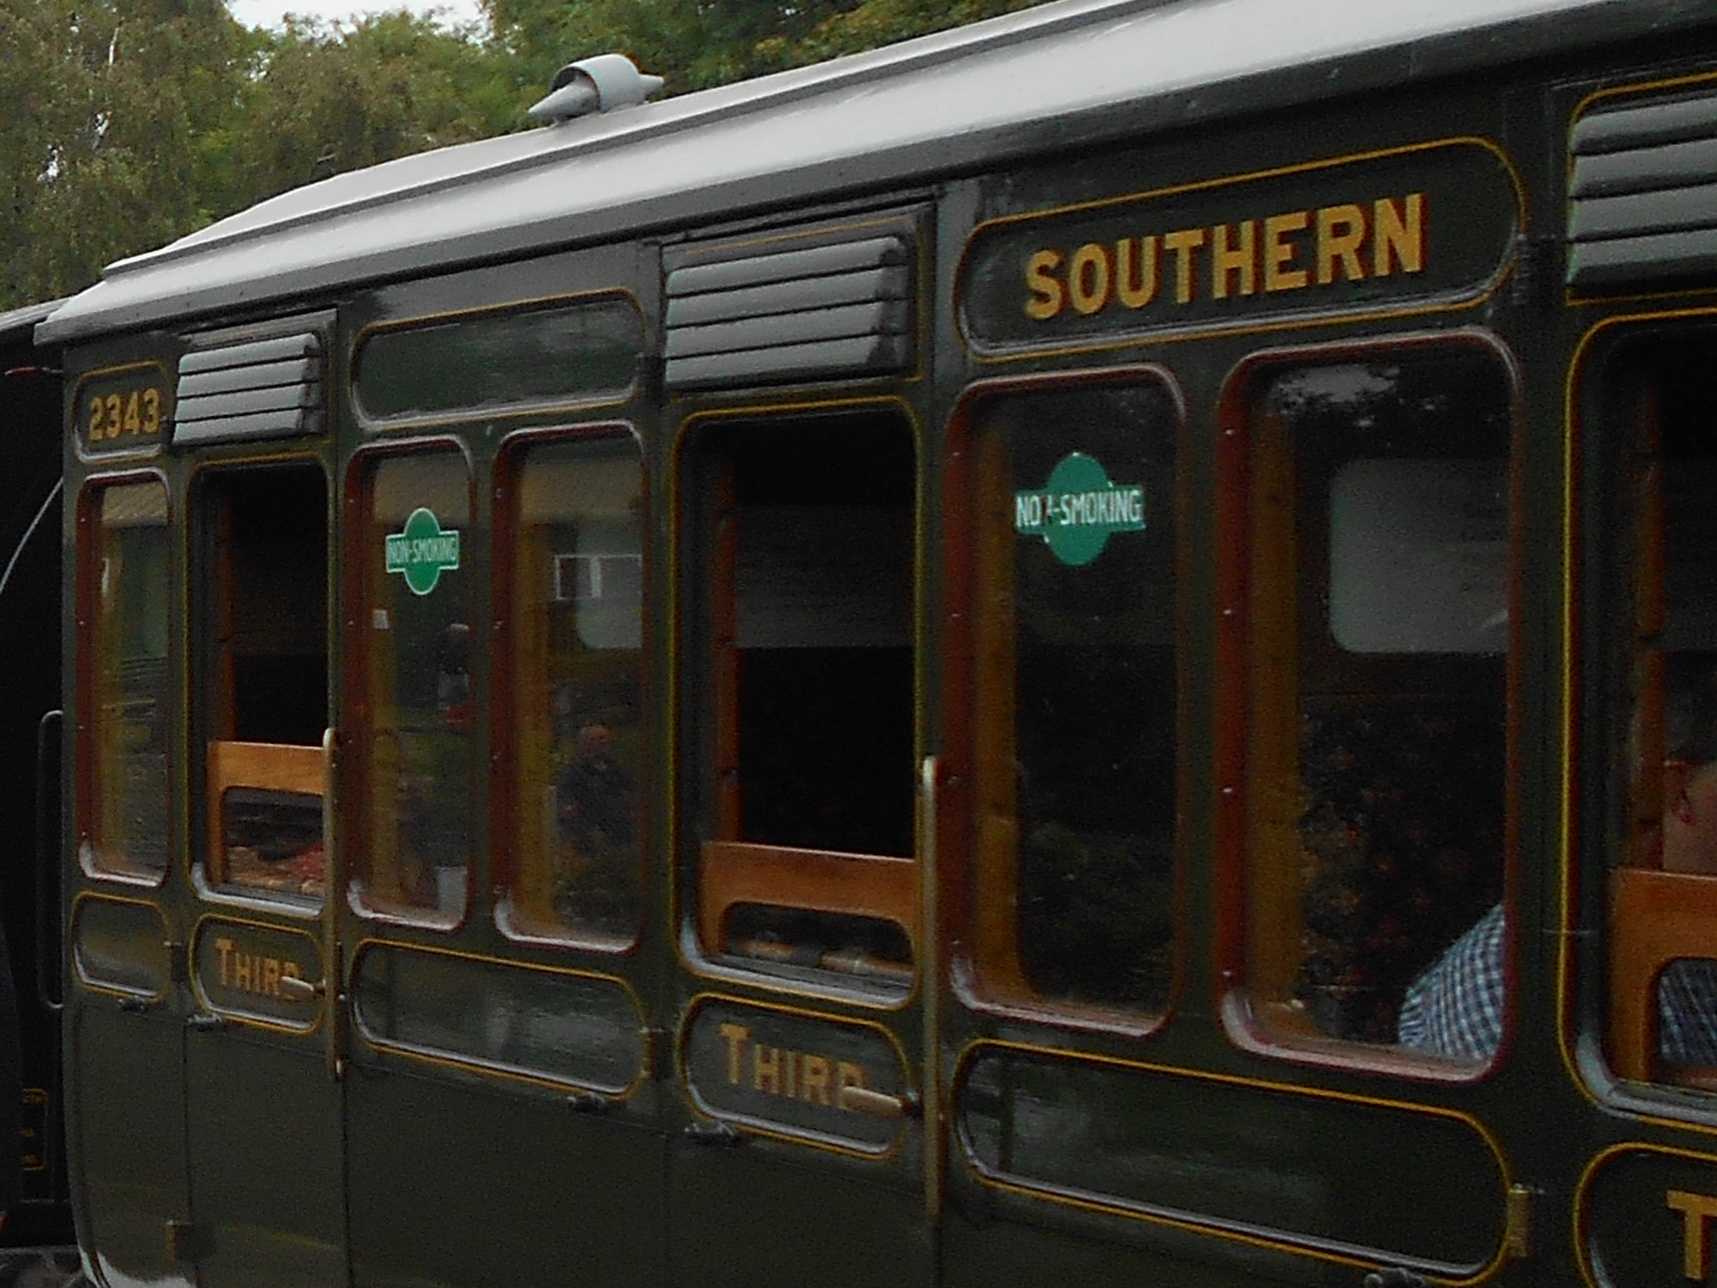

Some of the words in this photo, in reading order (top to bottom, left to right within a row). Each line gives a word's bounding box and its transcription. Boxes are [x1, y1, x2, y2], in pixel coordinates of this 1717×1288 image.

[1024, 191, 1427, 321] SOUTHERN
[88, 387, 161, 441] 2343
[387, 536, 457, 565] NON-SMOKING
[215, 938, 300, 1000] THIRD
[720, 1022, 869, 1111] THIRD
